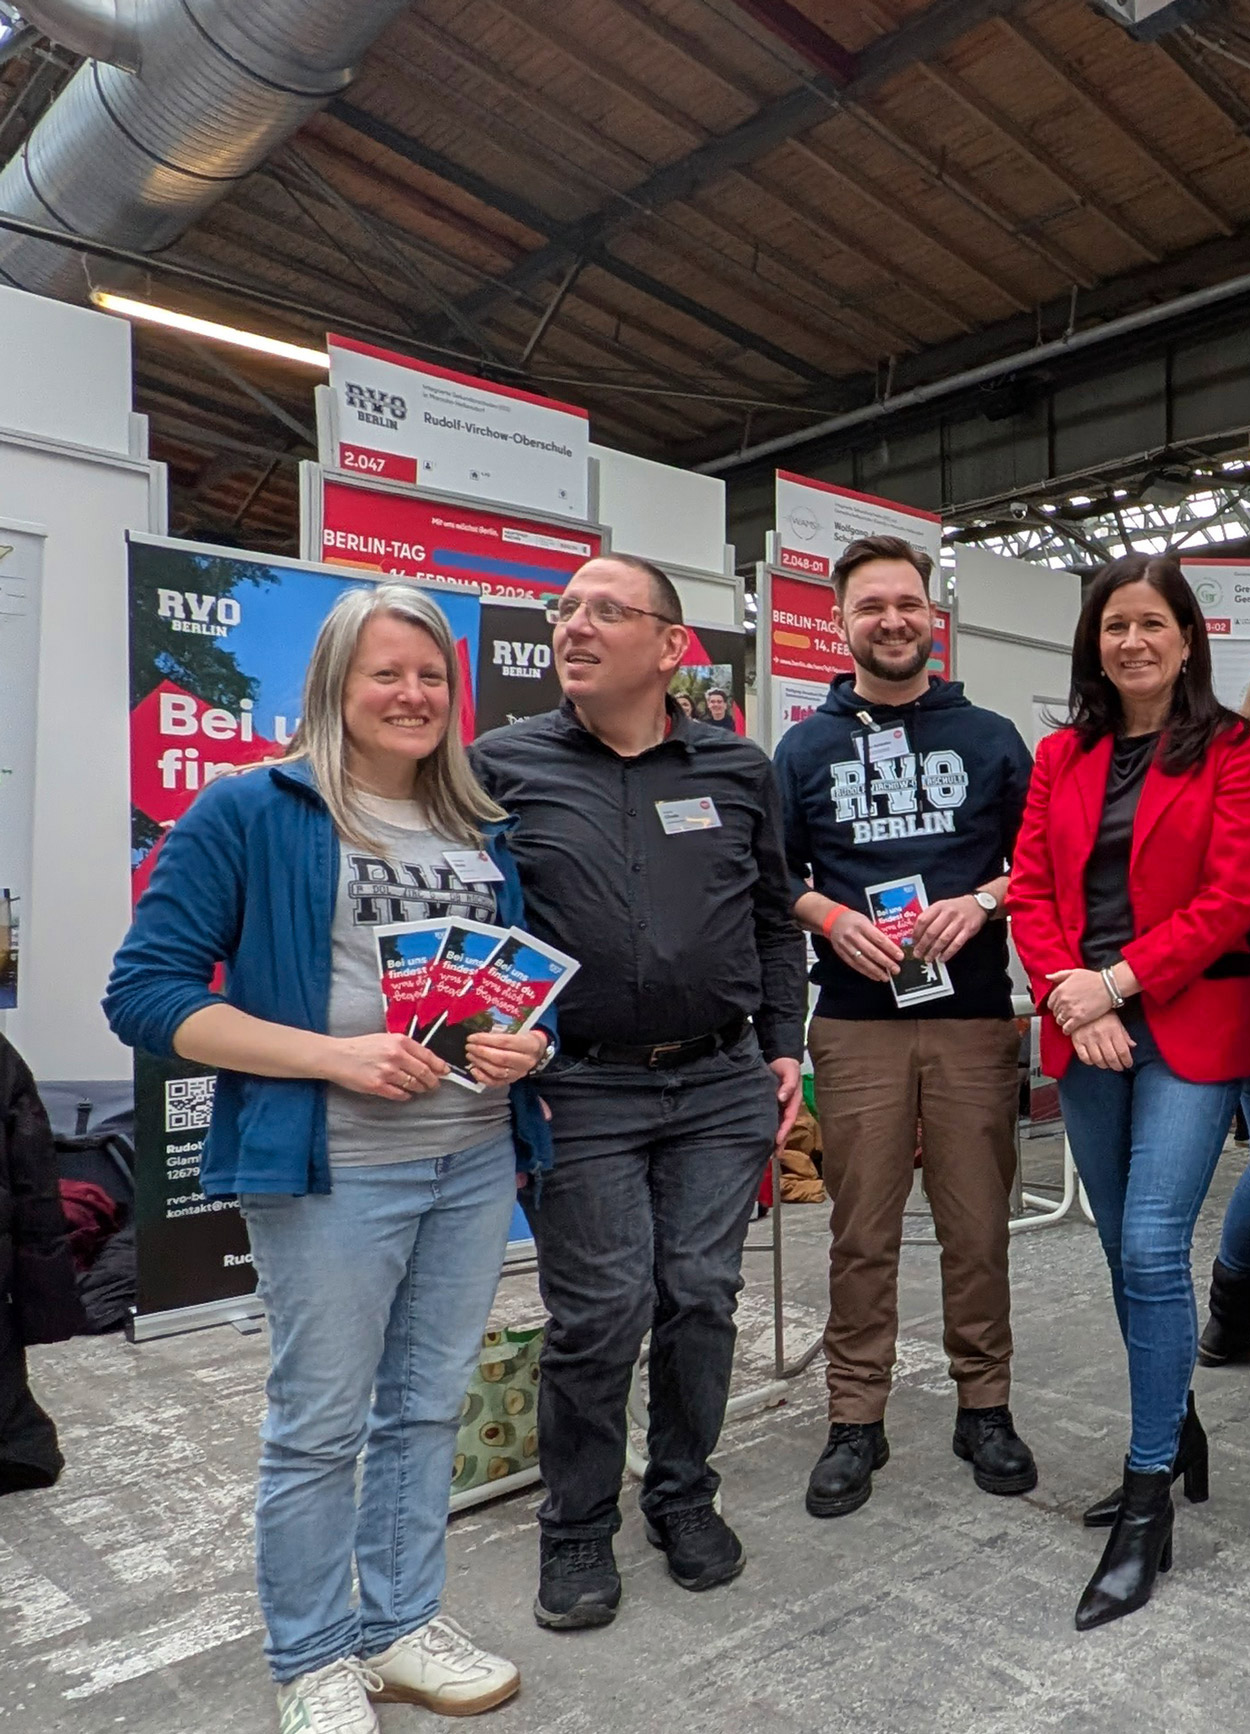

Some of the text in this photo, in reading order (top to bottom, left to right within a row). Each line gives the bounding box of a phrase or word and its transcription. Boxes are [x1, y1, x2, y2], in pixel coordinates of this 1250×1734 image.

[357, 410, 399, 431] BERLIN
[423, 411, 573, 458] Rudolf-Virchow-Oberschule
[343, 451, 386, 473] 2.047
[322, 529, 426, 562] BERLIN-TAG
[782, 553, 824, 573] 2.048-01
[156, 587, 241, 627] RVO
[171, 619, 228, 638] BERLIN
[772, 609, 837, 635] BERLIN-TAG
[492, 639, 551, 669] RVO
[814, 638, 853, 657] 14. FEB
[501, 666, 542, 679] BERLIN
[158, 692, 254, 743] Bei
[829, 748, 969, 824] RVO
[852, 810, 956, 845] BERLIN
[166, 1167, 200, 1180] 12679
